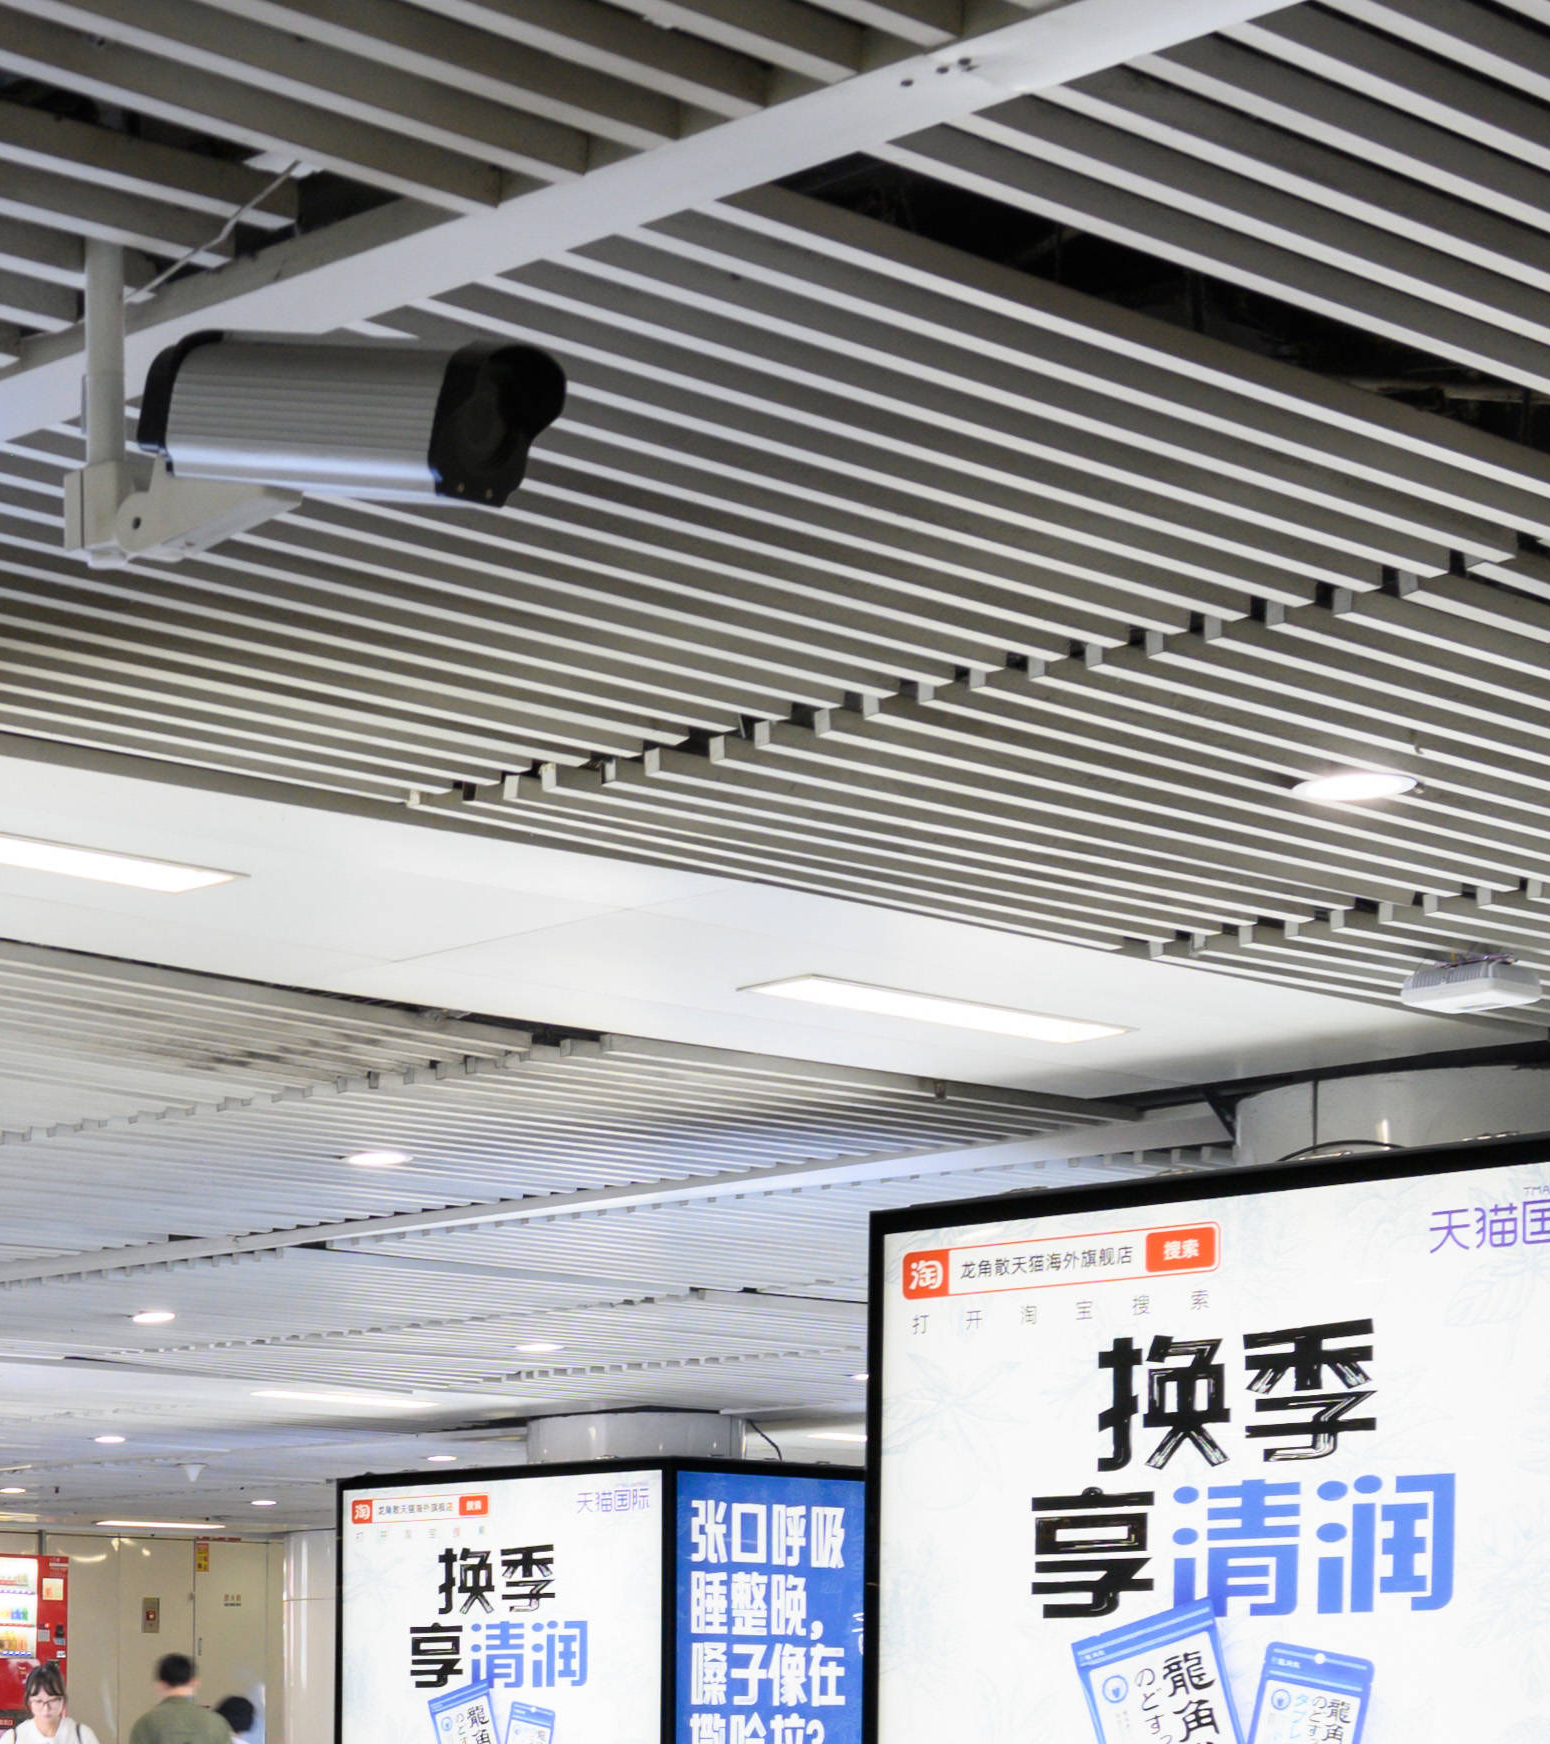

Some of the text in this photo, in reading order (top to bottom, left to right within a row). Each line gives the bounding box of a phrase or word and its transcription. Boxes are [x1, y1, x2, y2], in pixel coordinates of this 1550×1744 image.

[909, 1238, 1200, 1291] 淘 龙角散天猫海外旗舰店 搜索
[911, 1288, 1211, 1336] 打开淘宝搜索
[1097, 1318, 1378, 1473] 换季
[577, 1488, 649, 1513] 天猫国际
[690, 1499, 845, 1571] 张口呼吸
[437, 1543, 556, 1616] 换季
[1030, 1471, 1456, 1619] 享清润
[689, 1570, 824, 1640] 睡整晚，
[409, 1620, 589, 1689] 享清润
[689, 1642, 846, 1707] 嗓子像在
